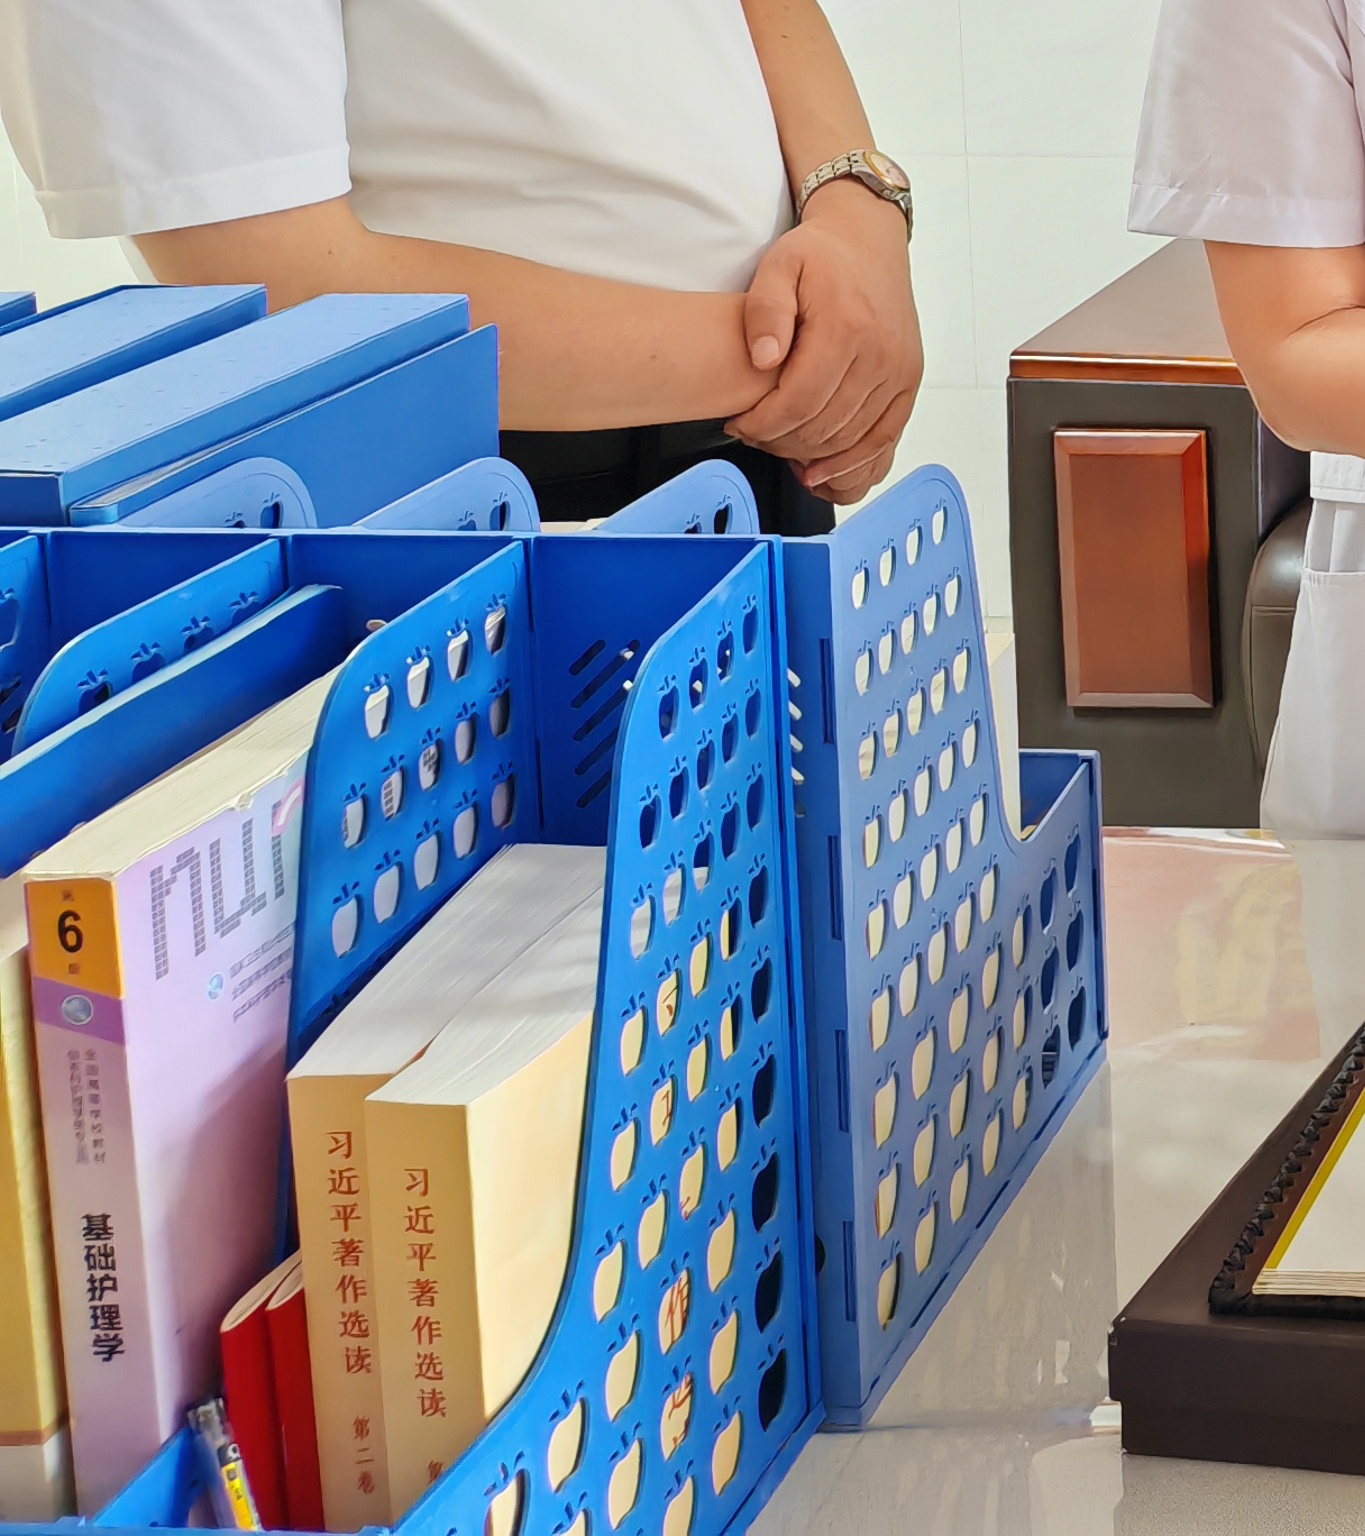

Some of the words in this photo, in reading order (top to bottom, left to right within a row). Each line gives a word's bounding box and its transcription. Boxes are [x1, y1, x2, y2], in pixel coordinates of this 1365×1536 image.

[57, 909, 84, 953] 6
[80, 1212, 126, 1363] 基础护理学
[324, 1130, 374, 1376] 习近平著作选读
[353, 1415, 375, 1494] 第二卷
[404, 1167, 449, 1418] 习近平著作选读
